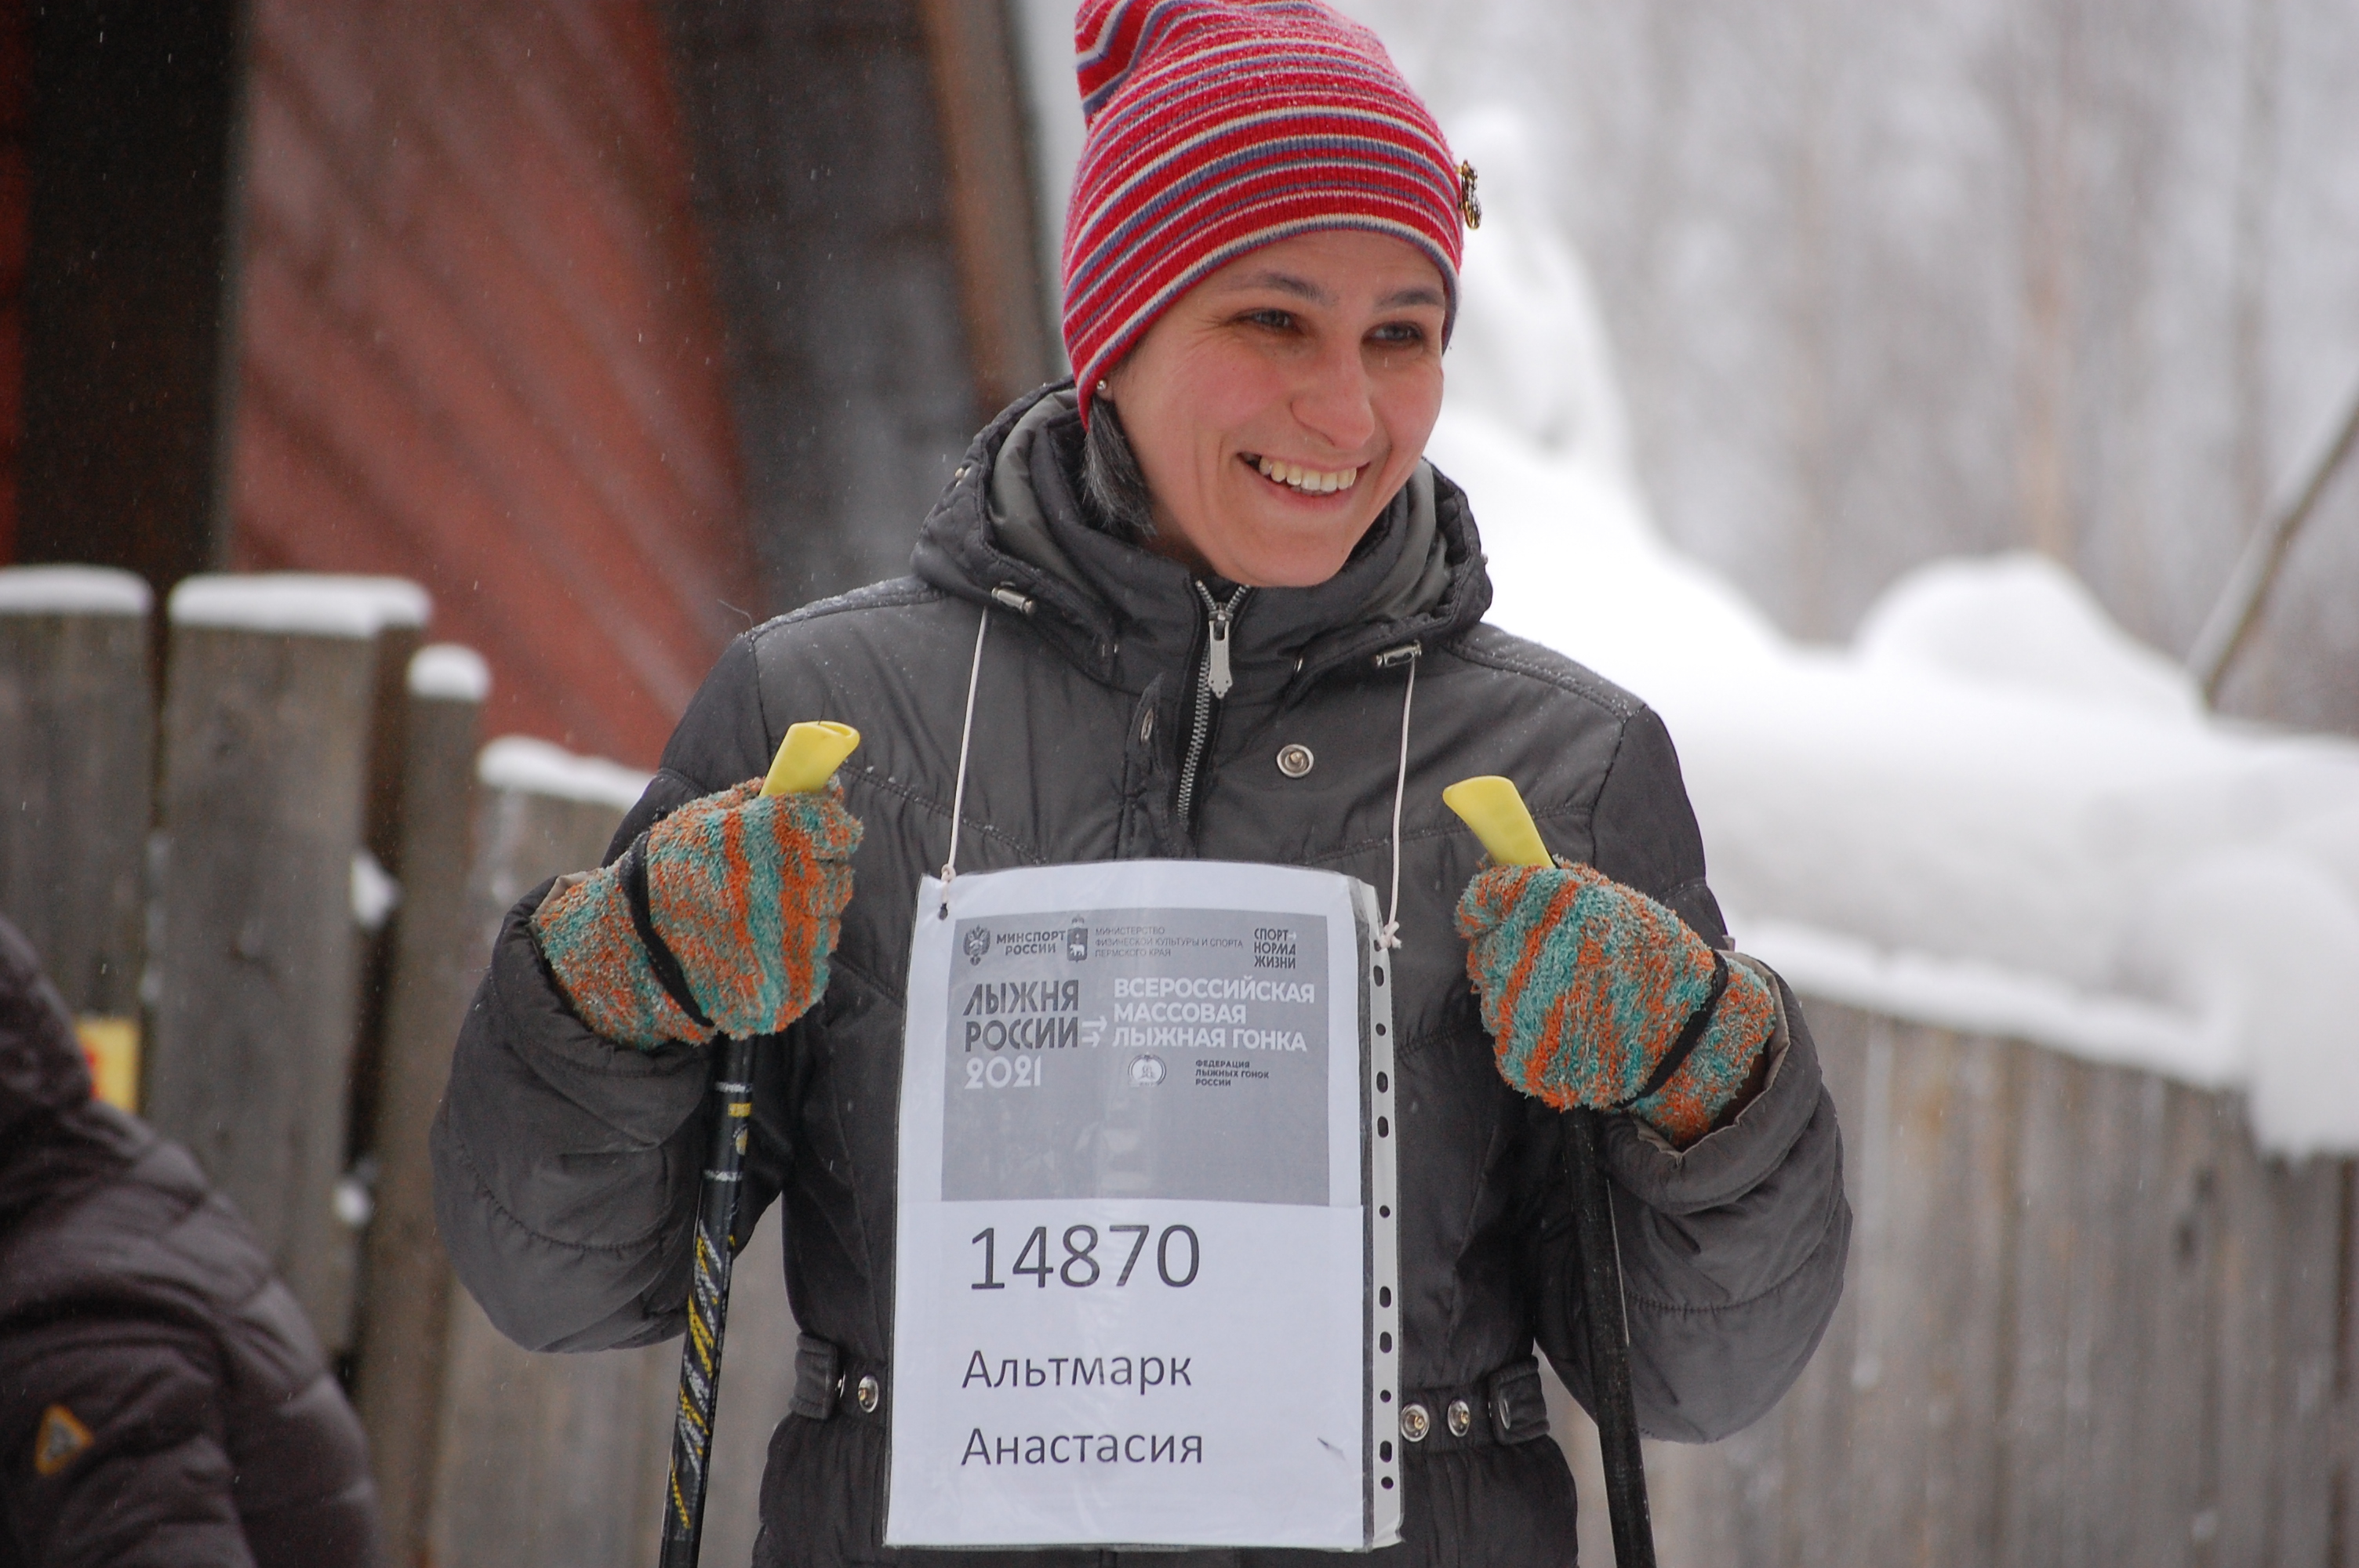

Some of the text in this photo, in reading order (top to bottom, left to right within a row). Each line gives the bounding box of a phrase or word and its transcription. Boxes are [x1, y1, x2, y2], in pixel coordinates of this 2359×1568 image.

[997, 931, 1066, 945] МИНСПОРТ
[1201, 938, 1208, 947] И
[1209, 939, 1244, 949] СПОРТА
[1254, 927, 1289, 943] СПОРТ
[1005, 943, 1056, 956] РОССИИ
[1149, 949, 1172, 957] КРАЯ
[1254, 942, 1296, 956] НОРМА
[1254, 955, 1296, 970] ЖИЗНИ
[962, 979, 1079, 1016] ЛЫЖНЯ
[1114, 975, 1315, 1004] ВСЕРОССИЙСКАЯ
[1114, 1004, 1247, 1025] МАССОВАЯ
[965, 1016, 1079, 1053] РОССИИ
[1112, 1026, 1308, 1053] ЛЫЖНАЯ ГОНКА
[964, 1054, 1041, 1090] 2021
[1195, 1059, 1250, 1069] ФЕДЕРАЦИЯ
[1195, 1069, 1270, 1080] ЛЫЖНЫХ ГОНОК
[969, 1224, 1201, 1290] 14870
[961, 1349, 1192, 1396] Альтмарк
[960, 1427, 1204, 1466] Анастасия
